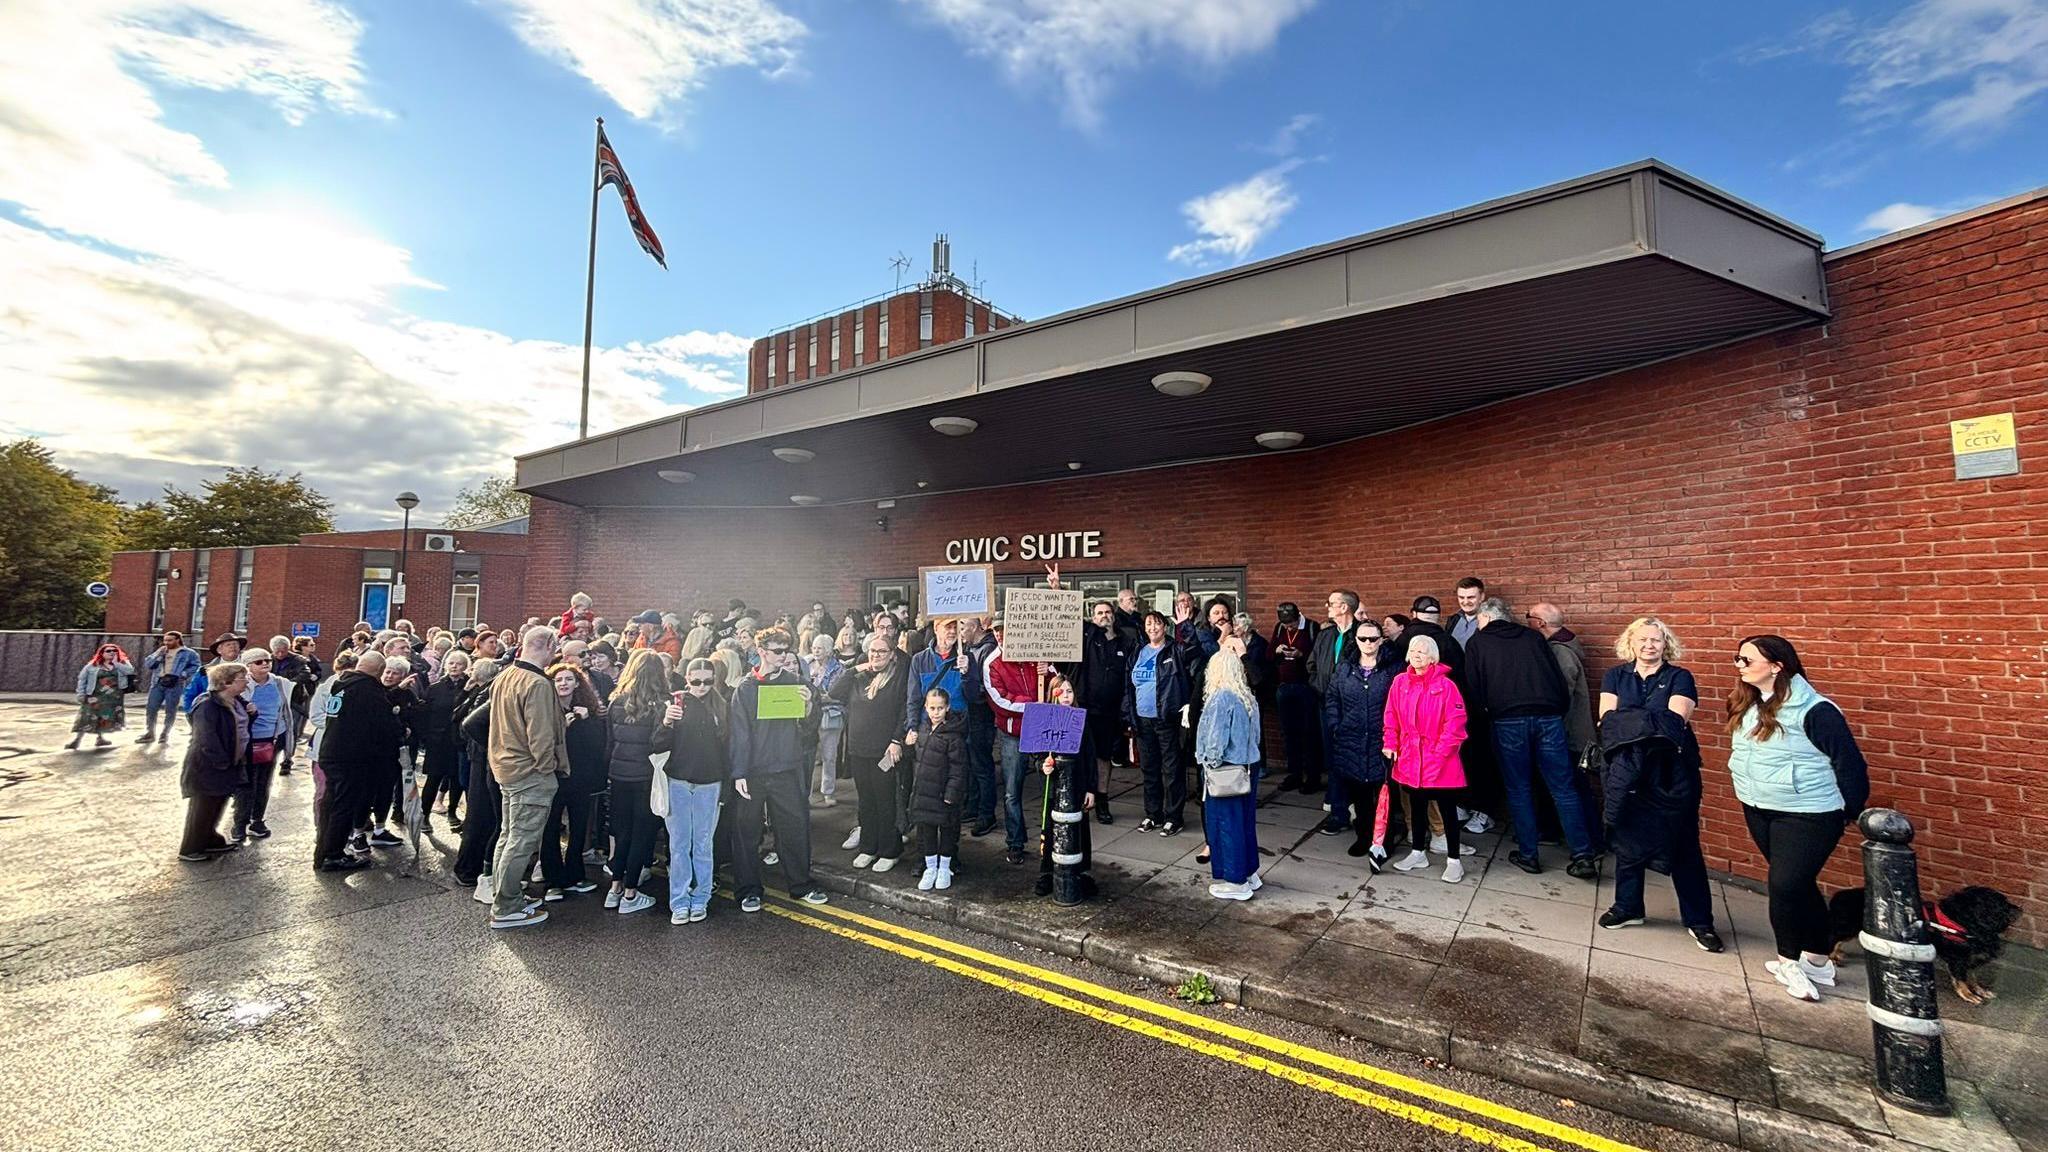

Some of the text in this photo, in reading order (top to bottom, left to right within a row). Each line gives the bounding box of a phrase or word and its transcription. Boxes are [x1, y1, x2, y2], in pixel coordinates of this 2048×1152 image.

[1965, 434, 2001, 447] CCTV
[945, 531, 1101, 564] CIVIC SUITE
[935, 574, 968, 585] SAVE
[1010, 592, 1019, 601] IF
[1022, 592, 1041, 601] CCDC
[1044, 593, 1064, 601] WANT
[1009, 603, 1027, 611] GIVE
[1041, 729, 1069, 740] THE
